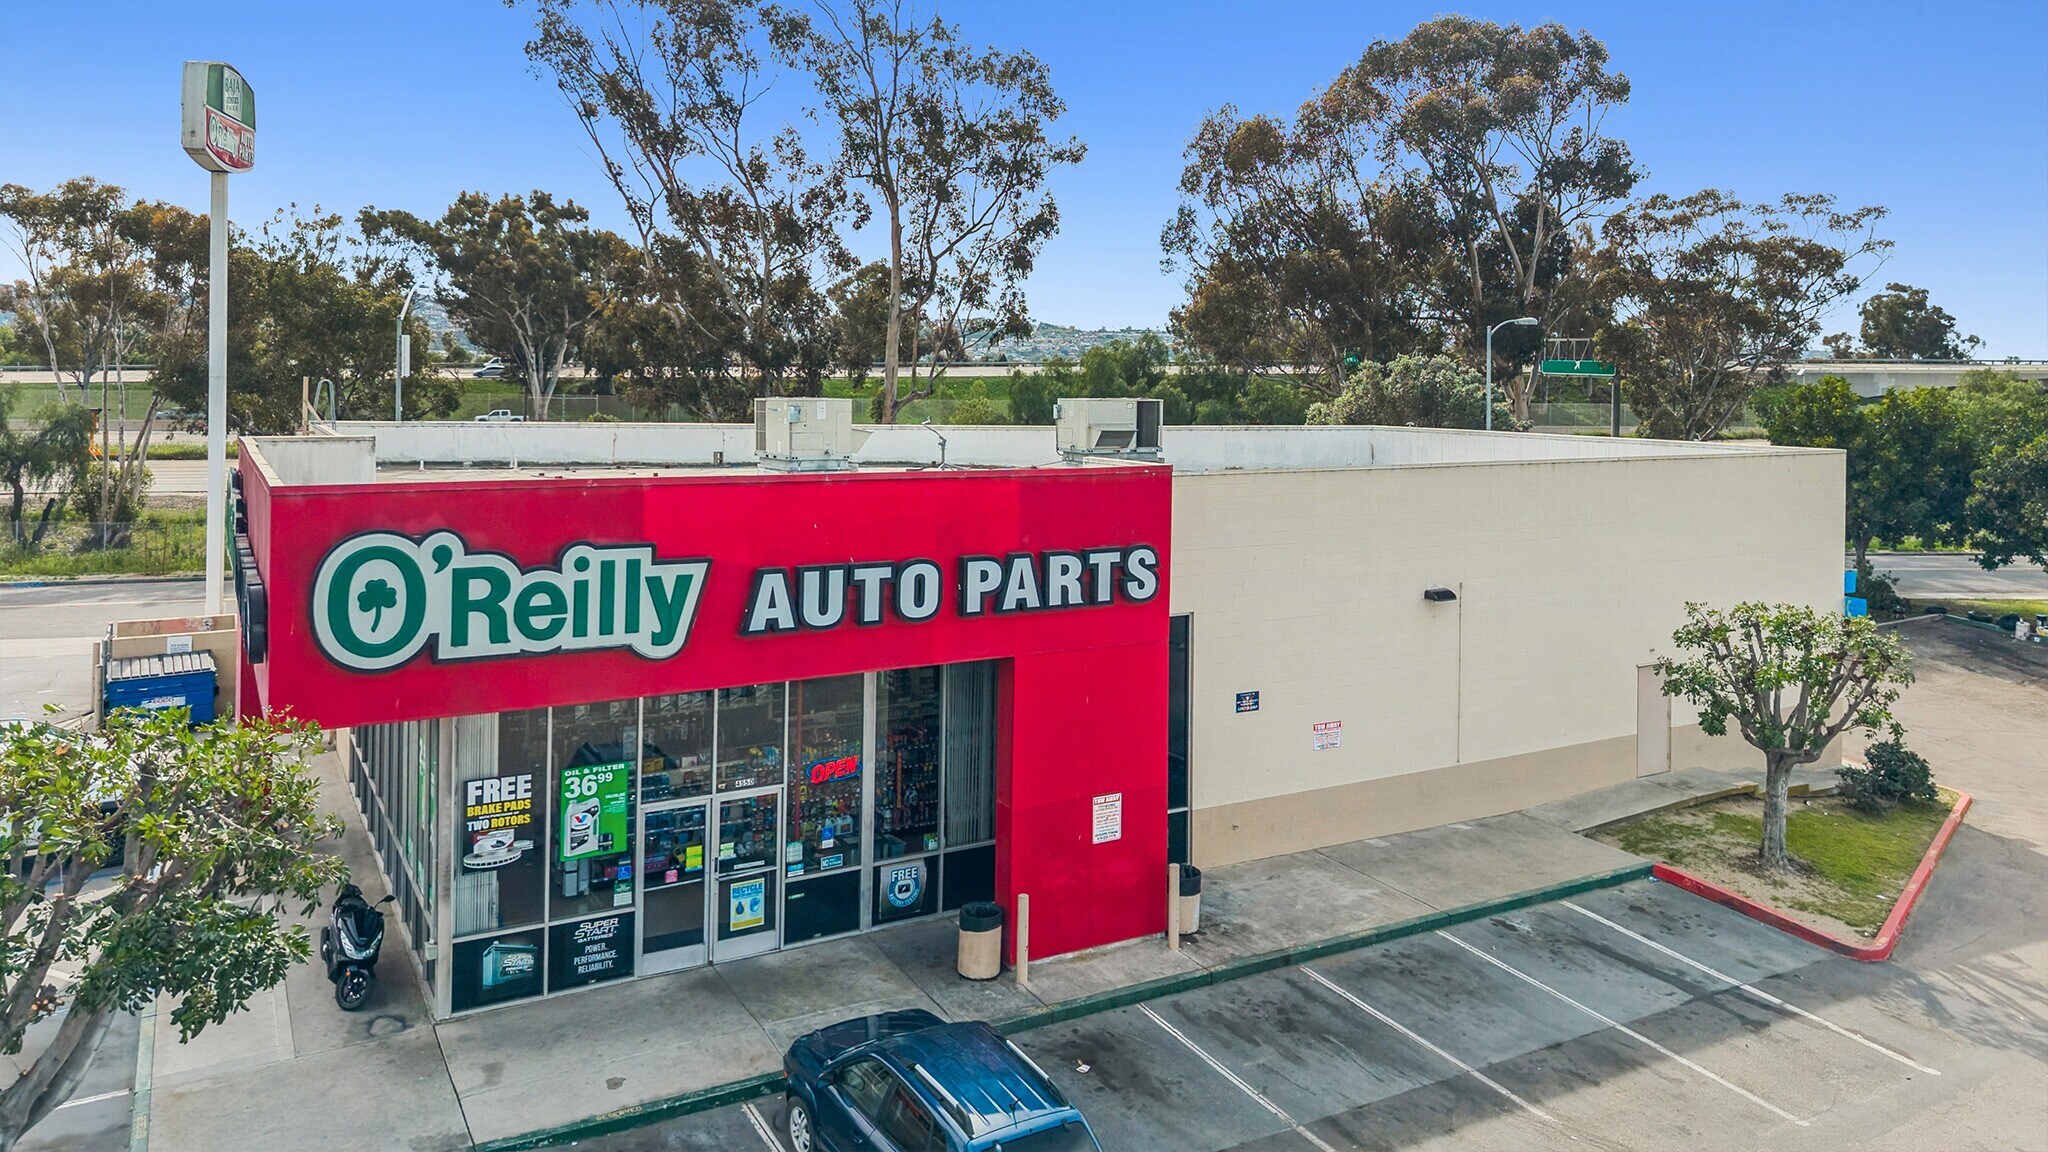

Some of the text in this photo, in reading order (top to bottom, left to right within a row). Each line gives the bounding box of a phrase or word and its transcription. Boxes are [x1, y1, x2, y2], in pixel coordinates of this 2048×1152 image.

[327, 544, 1157, 658] O'Reilly AUTO PARTS
[592, 763, 625, 773] FILTER
[811, 755, 857, 784] OPEN
[467, 774, 532, 806] FREE
[467, 799, 532, 817] BRAKE PADS
[467, 819, 490, 832] TWO
[490, 814, 531, 829] ROTORS
[891, 867, 918, 882] FREE
[732, 883, 763, 895] RECYCLE
[580, 917, 619, 930] SUPER
[577, 932, 614, 943] BATTERIES
[595, 1106, 642, 1121] RESERVED
